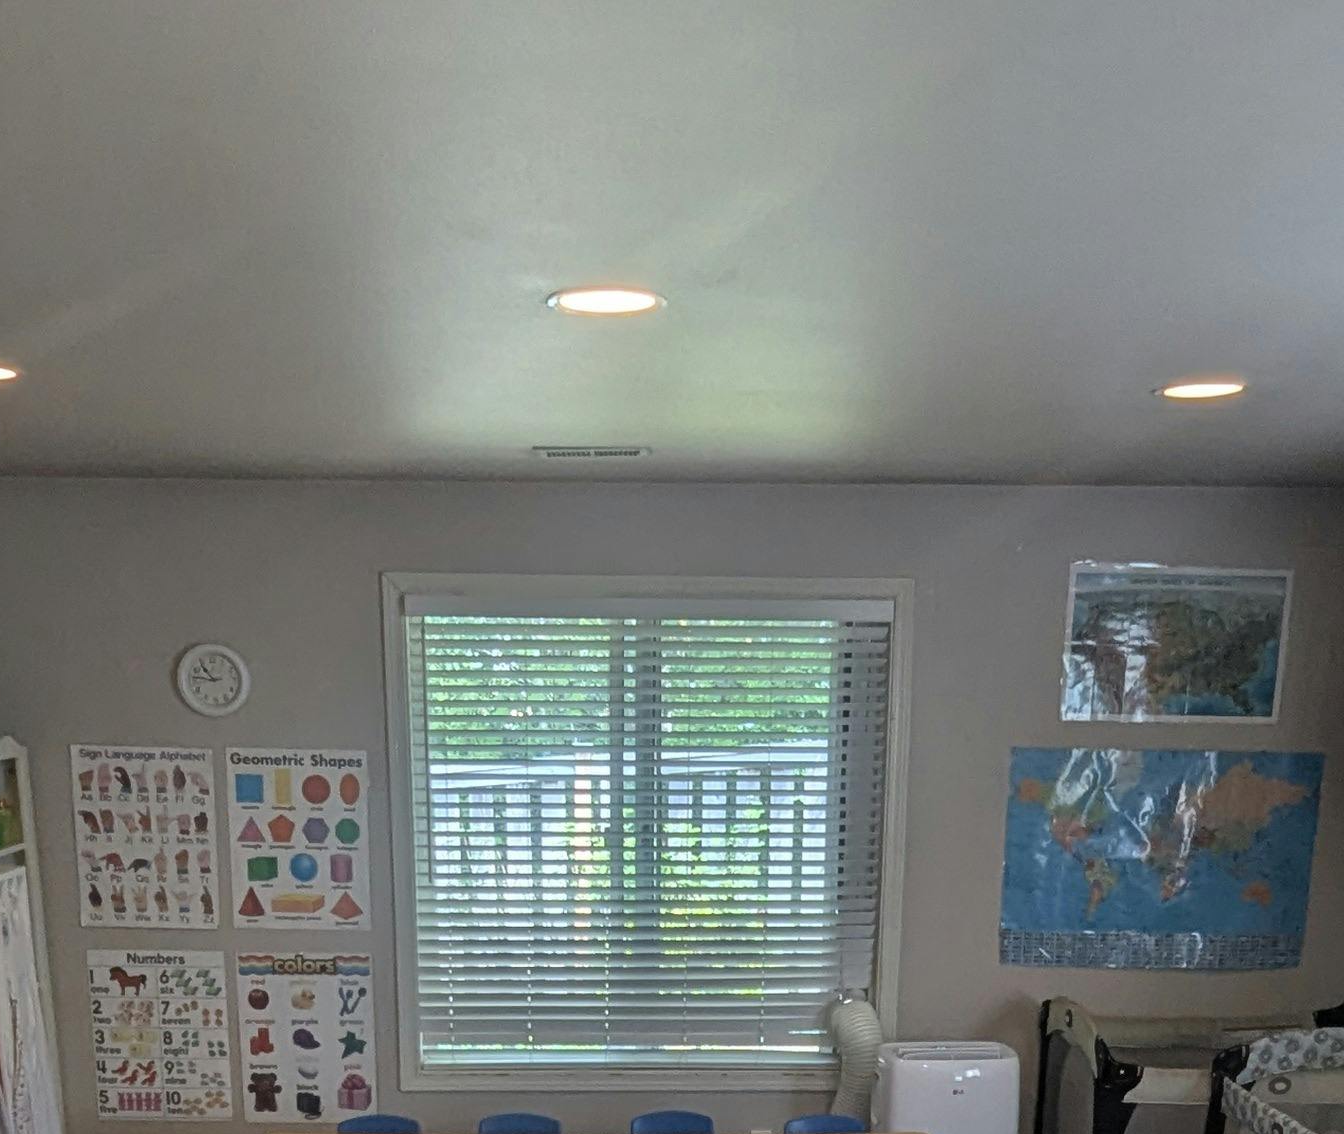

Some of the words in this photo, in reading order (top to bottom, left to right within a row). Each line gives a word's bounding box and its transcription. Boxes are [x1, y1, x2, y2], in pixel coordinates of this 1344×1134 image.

[79, 748, 103, 761] Sign
[104, 749, 157, 762] Language
[159, 750, 206, 763] Alphabet
[229, 752, 305, 767] Geometric
[310, 754, 364, 769] Shapes
[126, 953, 186, 965] Numbers
[273, 954, 337, 976] colors
[159, 970, 170, 985] 6
[92, 1000, 103, 1015] 2
[161, 1001, 171, 1016] 7
[95, 1029, 105, 1045] 3
[163, 1030, 173, 1046] 8
[97, 1060, 108, 1074] 4
[164, 1061, 175, 1075] 9
[98, 1090, 109, 1105] 5
[165, 1091, 182, 1105] 10
